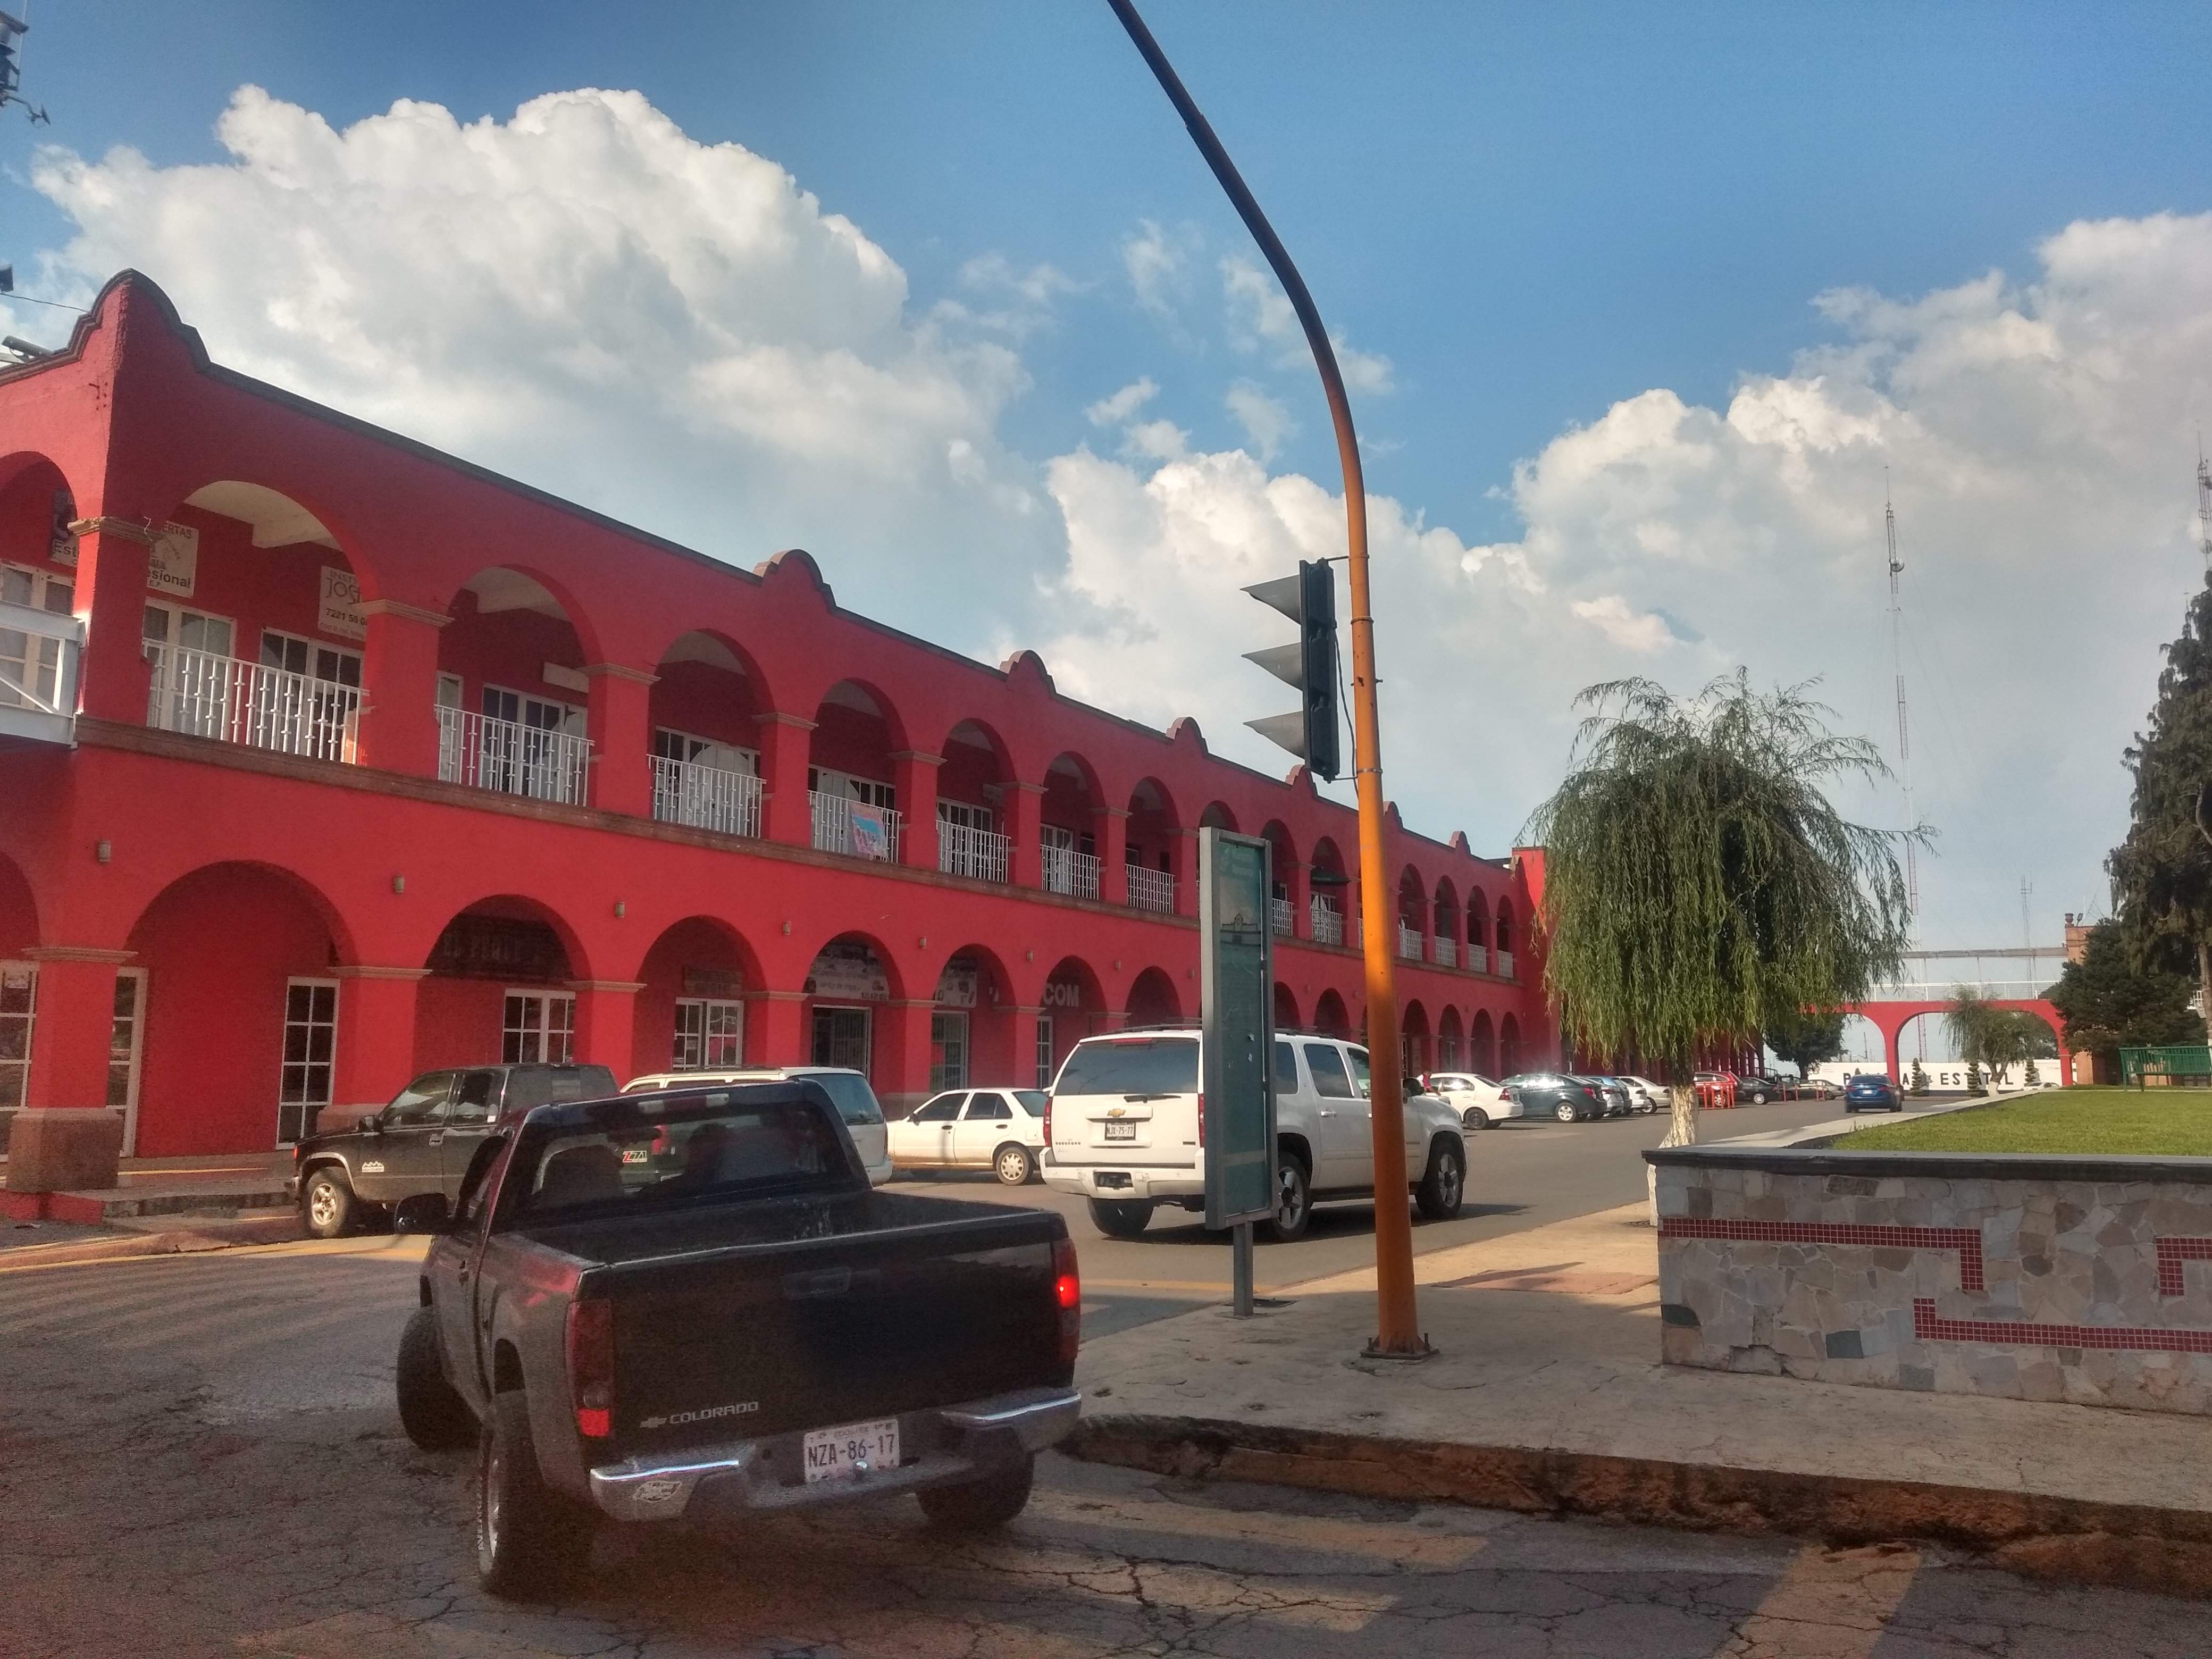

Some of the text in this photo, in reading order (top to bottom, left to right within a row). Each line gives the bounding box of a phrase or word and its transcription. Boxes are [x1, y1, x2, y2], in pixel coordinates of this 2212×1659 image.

[1043, 983, 1079, 1007] COM
[669, 1401, 759, 1425] COLORADO
[808, 1434, 894, 1468] NZA-86-17
